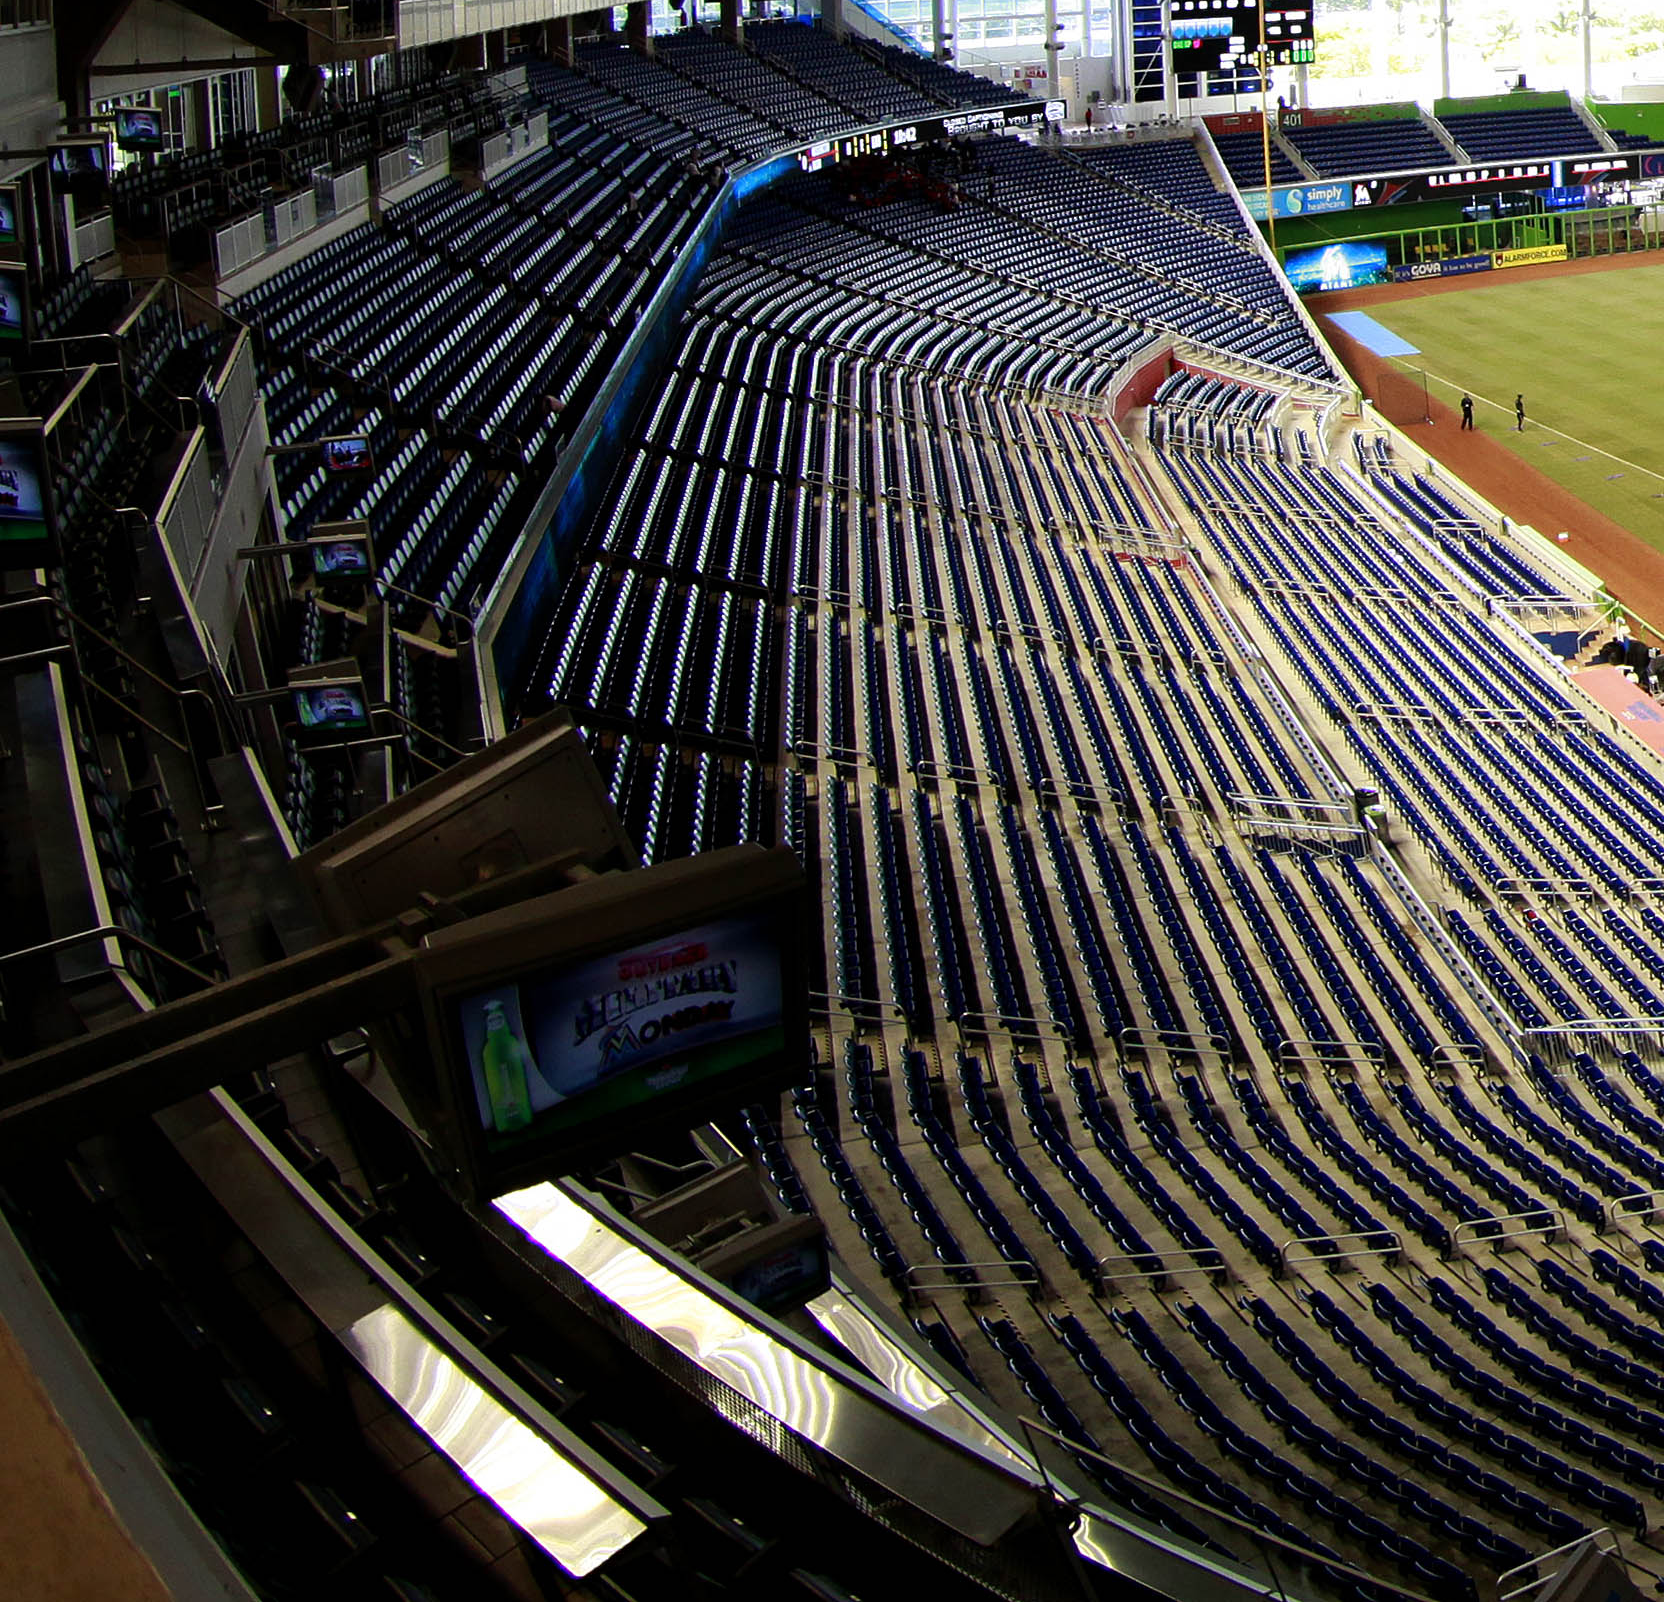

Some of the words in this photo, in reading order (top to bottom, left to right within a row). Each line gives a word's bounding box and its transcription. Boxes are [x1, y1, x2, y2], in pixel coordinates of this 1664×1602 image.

[948, 120, 990, 136] BROUGHT
[991, 119, 1005, 129] TO
[1007, 115, 1028, 126] YOU
[1031, 112, 1044, 122] BY
[1283, 113, 1302, 127] 401
[1307, 186, 1343, 201] simply
[1307, 199, 1346, 211] healthcare
[1504, 247, 1567, 263] ALARMFORCE.COM
[1411, 262, 1442, 276] GOYA
